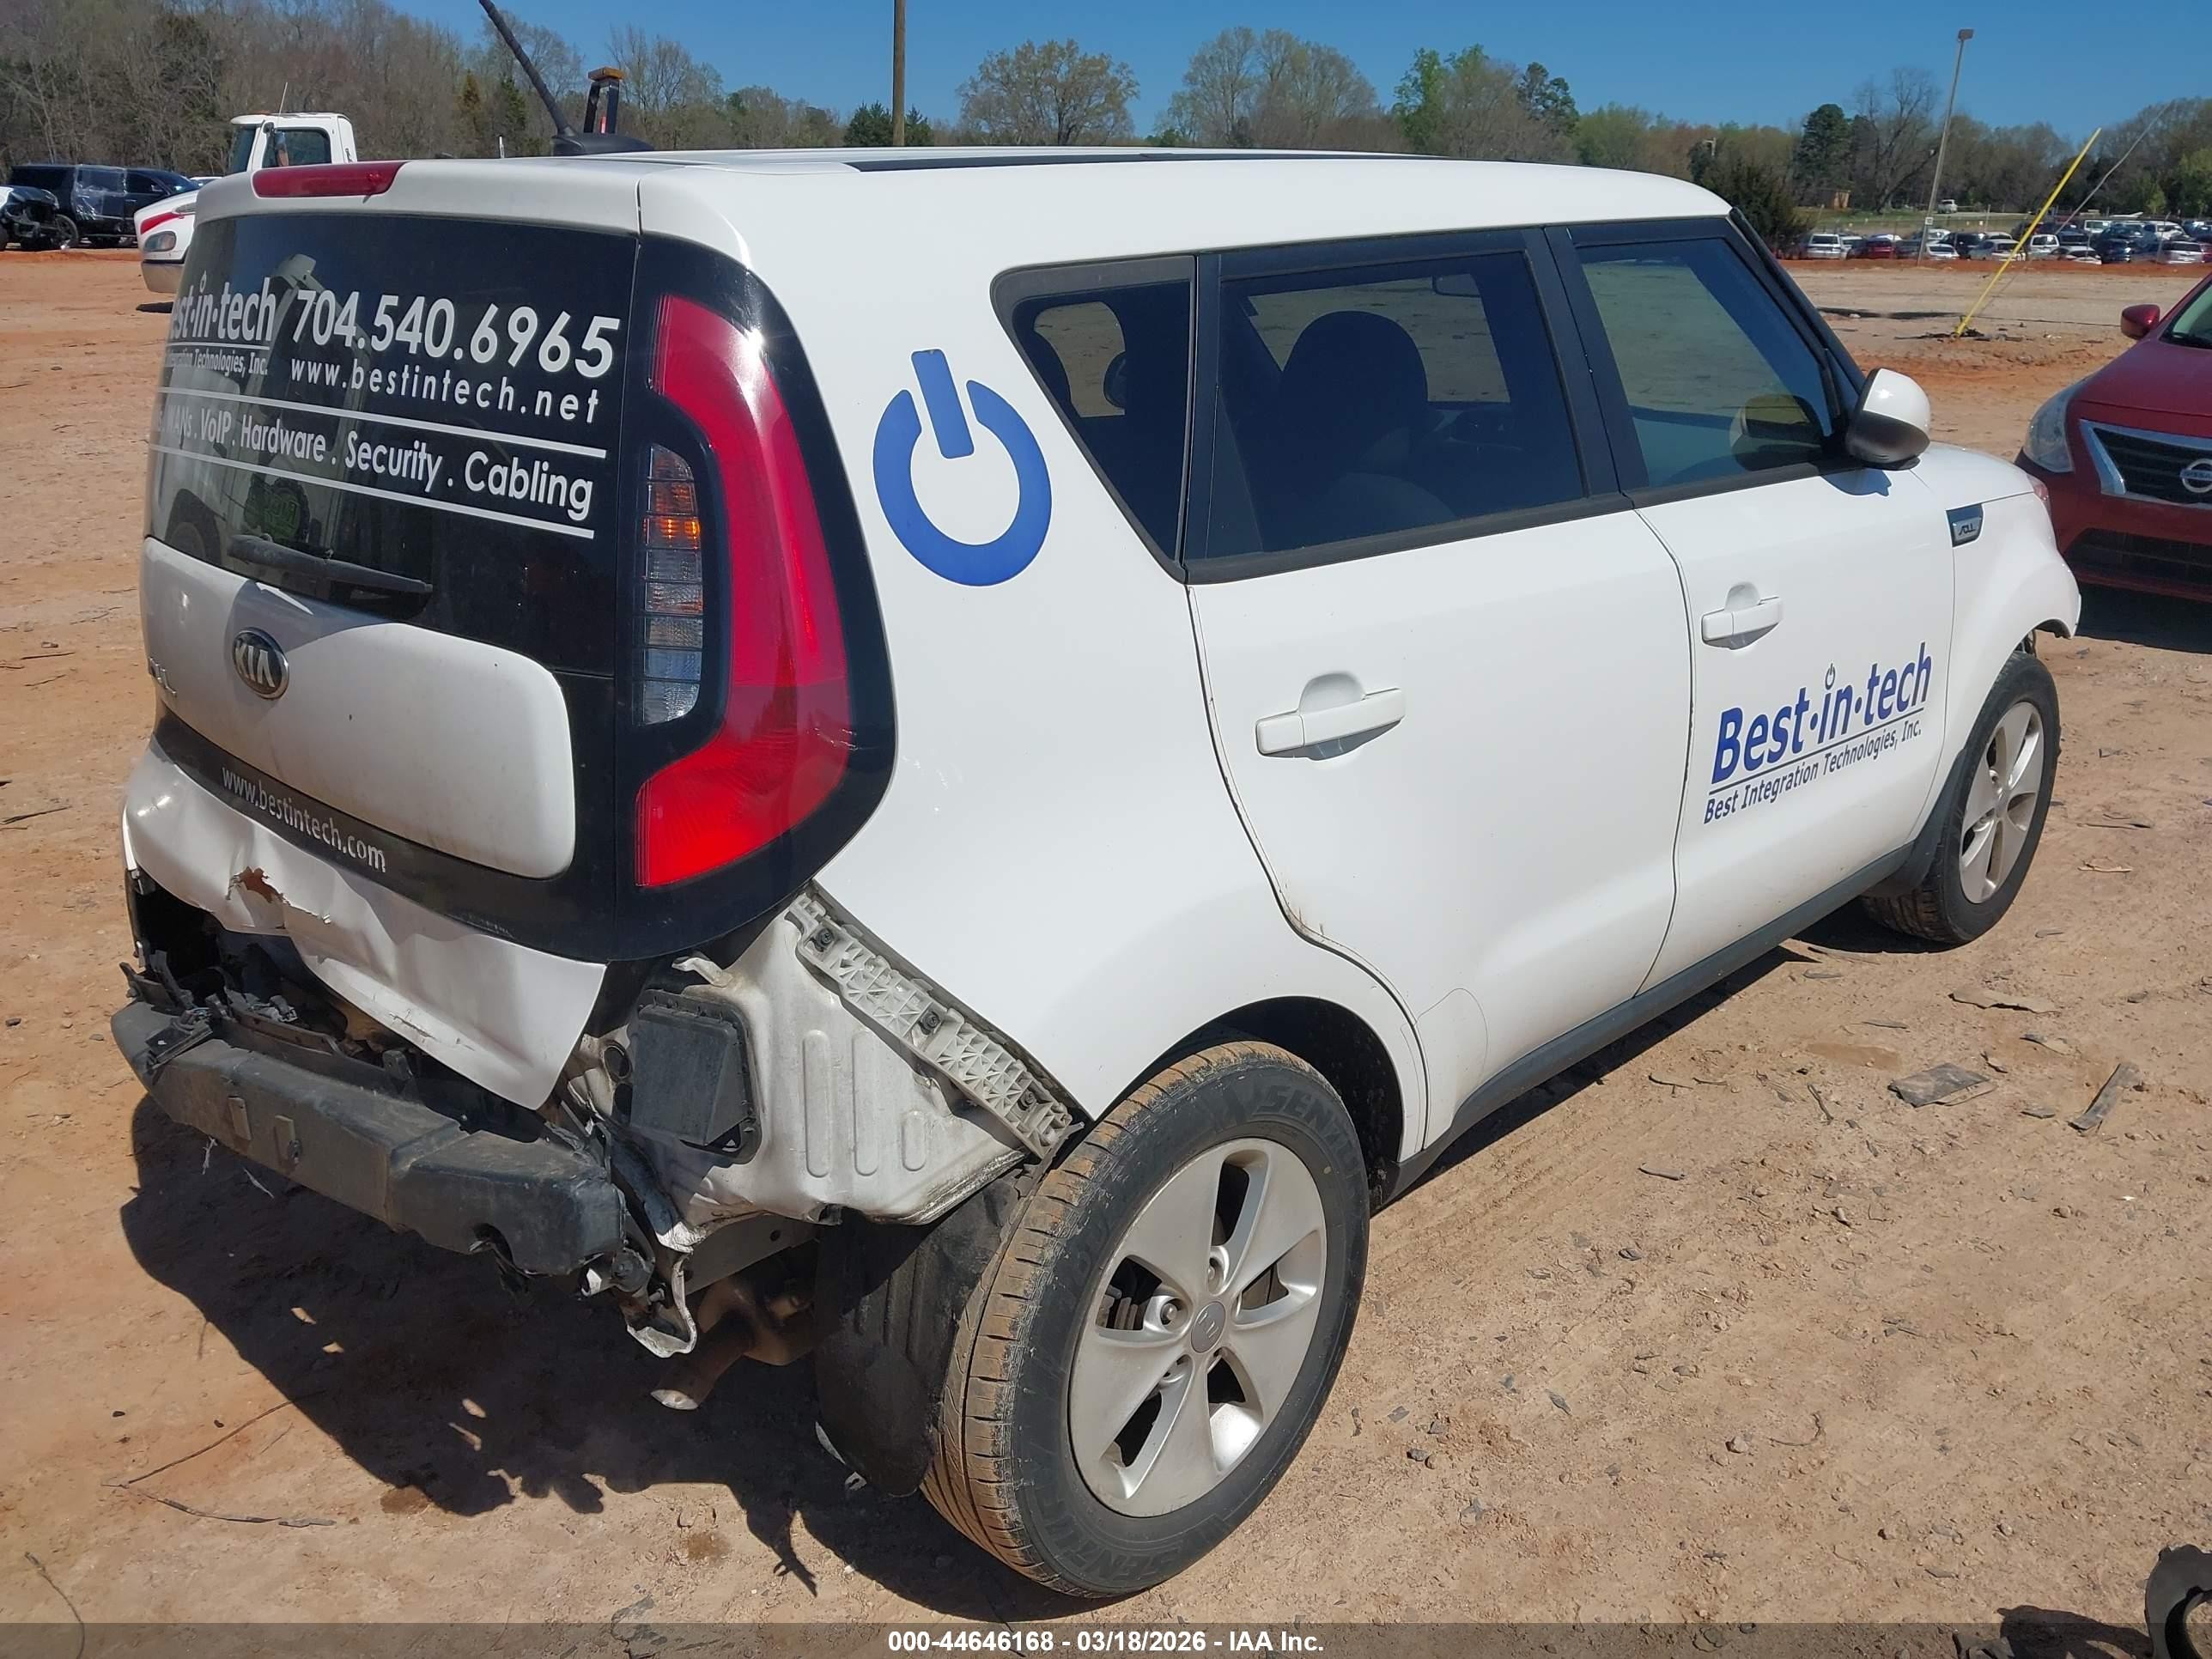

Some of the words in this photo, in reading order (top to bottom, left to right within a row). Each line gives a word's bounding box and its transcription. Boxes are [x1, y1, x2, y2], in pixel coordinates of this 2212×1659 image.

[247, 351, 268, 375] Inc.
[292, 290, 620, 379] 704.540.6965
[290, 357, 599, 423] www.bestintech.net
[200, 407, 232, 446] VoIP
[240, 413, 326, 463] Hardware
[344, 430, 443, 493] Security
[465, 451, 593, 521] Cabling
[233, 641, 277, 688] KIA
[1704, 795, 1739, 825] Best
[1741, 762, 1819, 810] Integration
[1822, 728, 1898, 776] Technologies,
[1901, 718, 1922, 743] Inc.
[221, 766, 386, 873] www.bestintech.com
